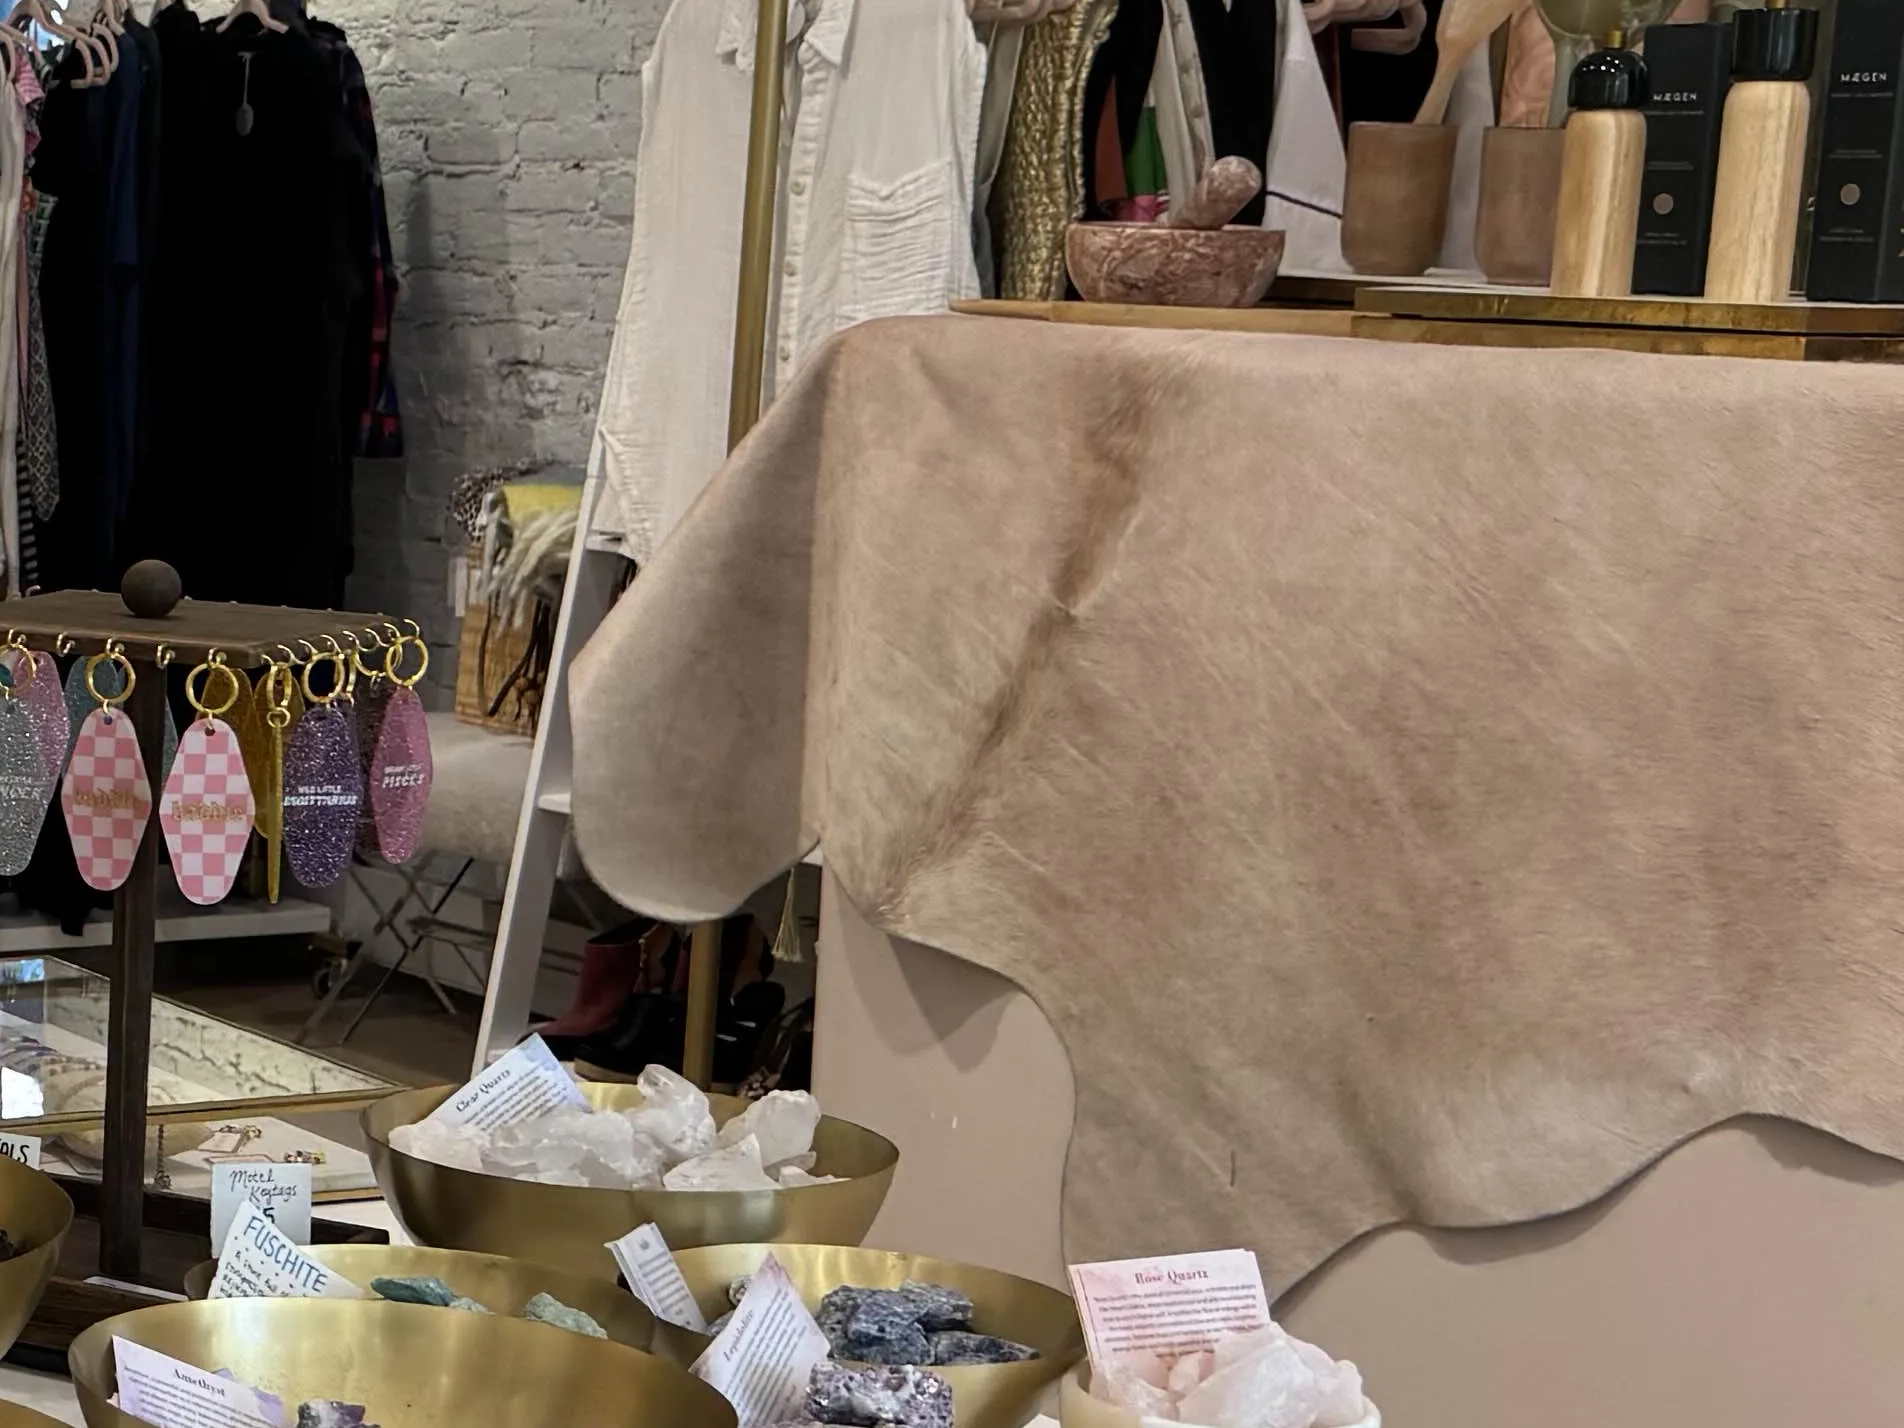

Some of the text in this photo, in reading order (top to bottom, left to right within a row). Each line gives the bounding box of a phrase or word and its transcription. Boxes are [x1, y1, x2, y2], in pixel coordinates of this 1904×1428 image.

[243, 1215, 329, 1293] FUSCHITE
[1134, 1268, 1209, 1285] Rose Quartz
[173, 1368, 226, 1398] Amethyst
